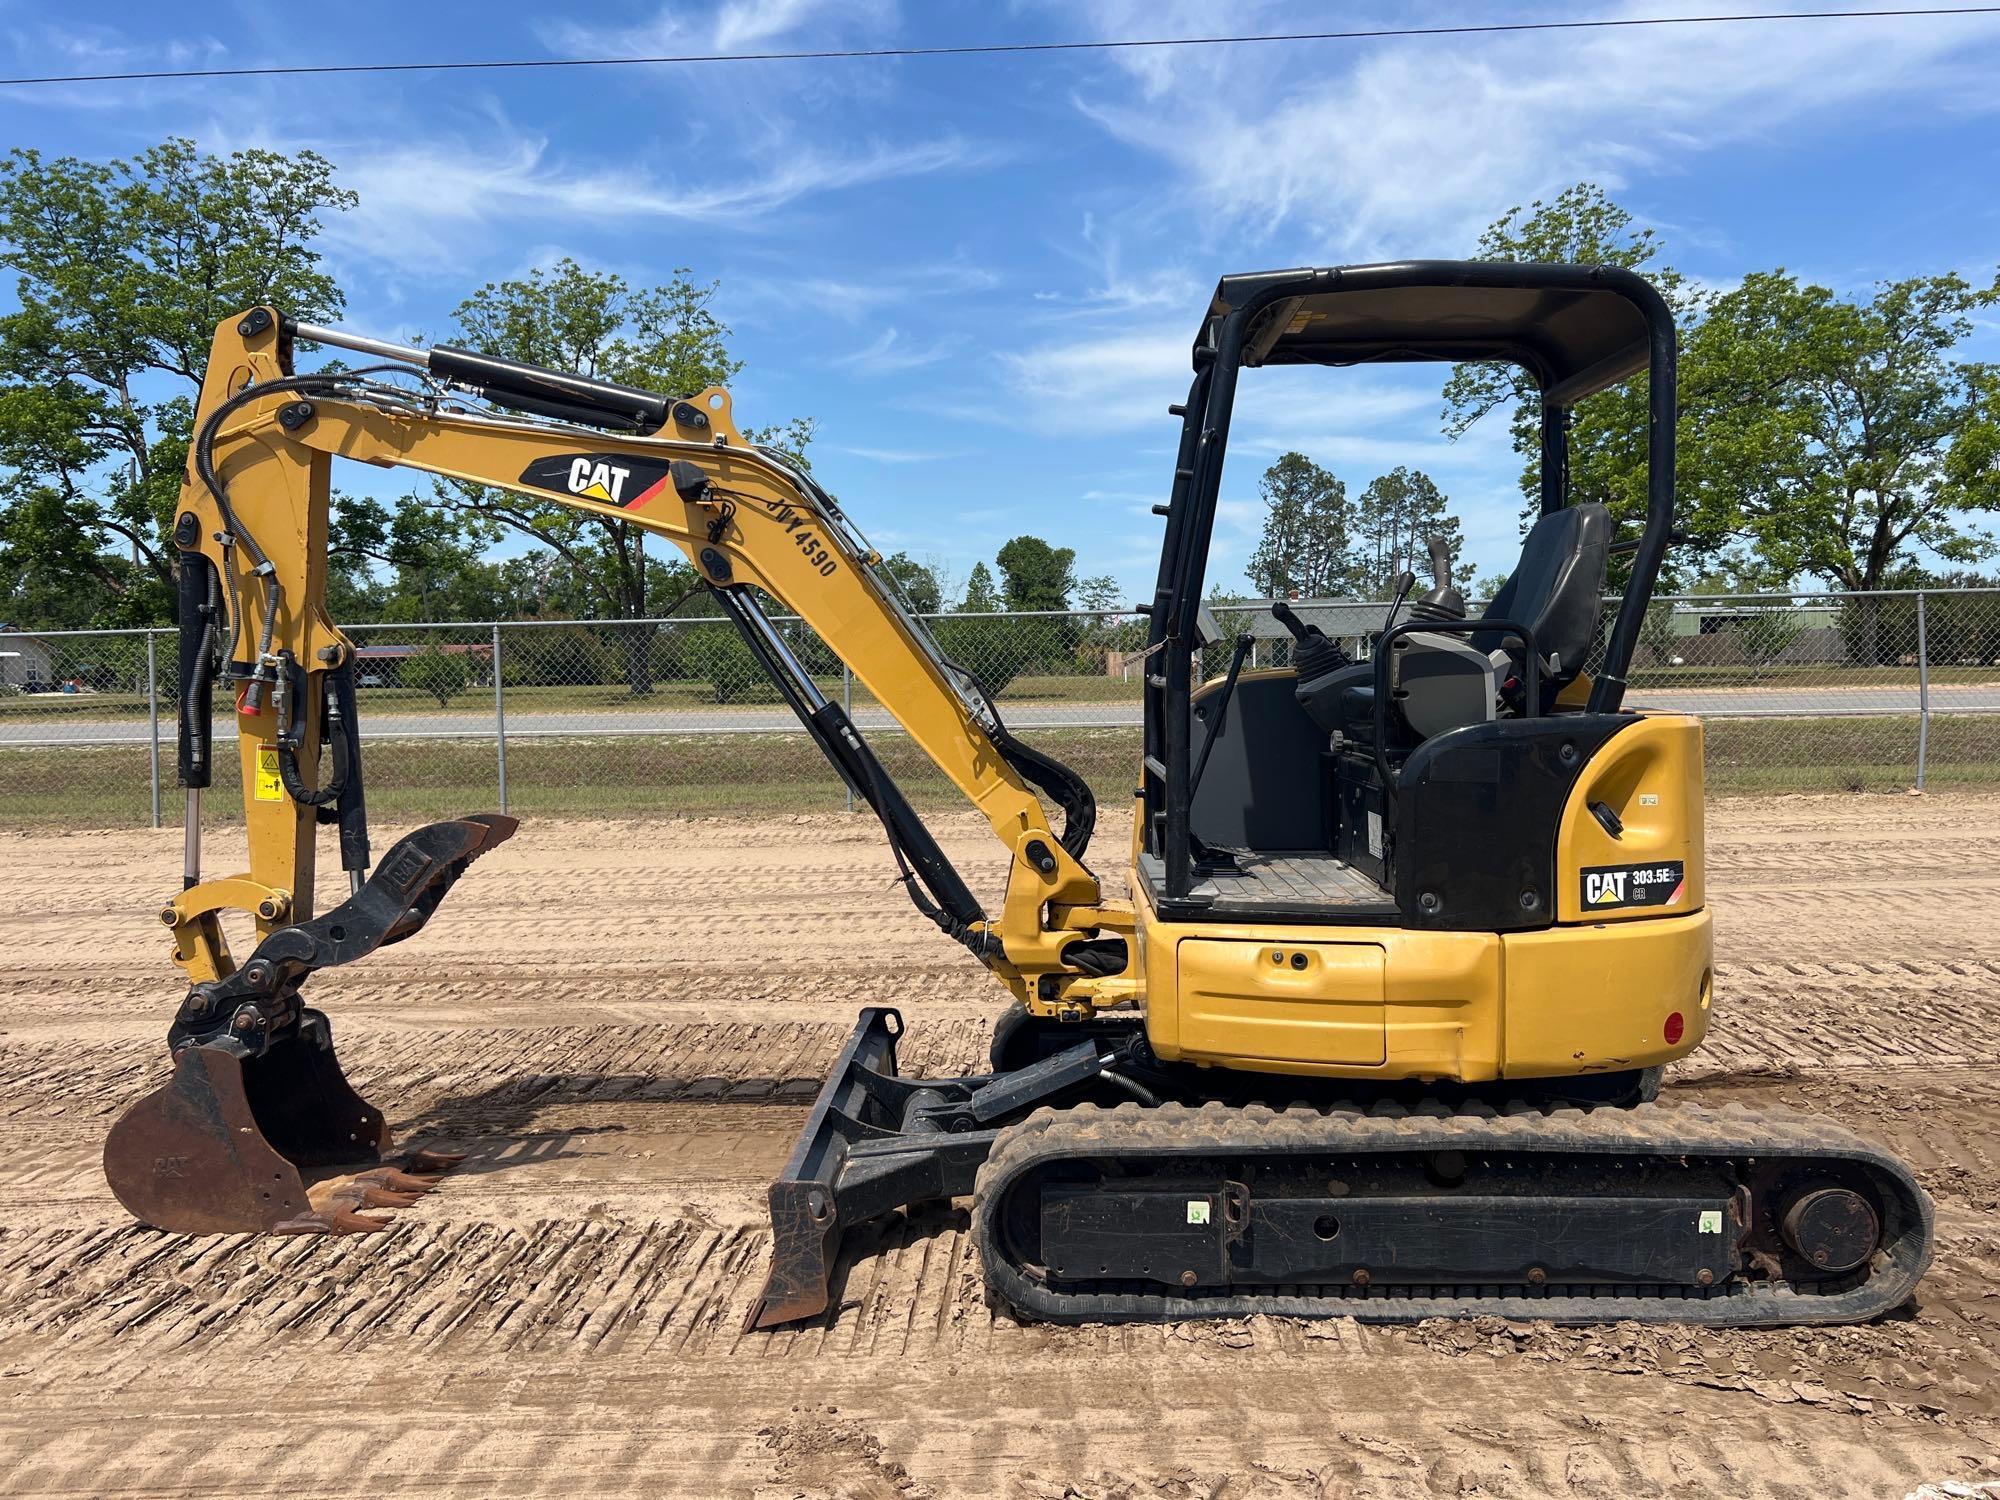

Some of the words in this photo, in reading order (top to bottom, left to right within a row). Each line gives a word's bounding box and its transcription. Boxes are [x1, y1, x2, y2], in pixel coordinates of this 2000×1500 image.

[568, 457, 631, 503] CAT
[766, 498, 837, 577] JWY4590
[1586, 871, 1627, 904] CAT
[1632, 887, 1646, 900] CR
